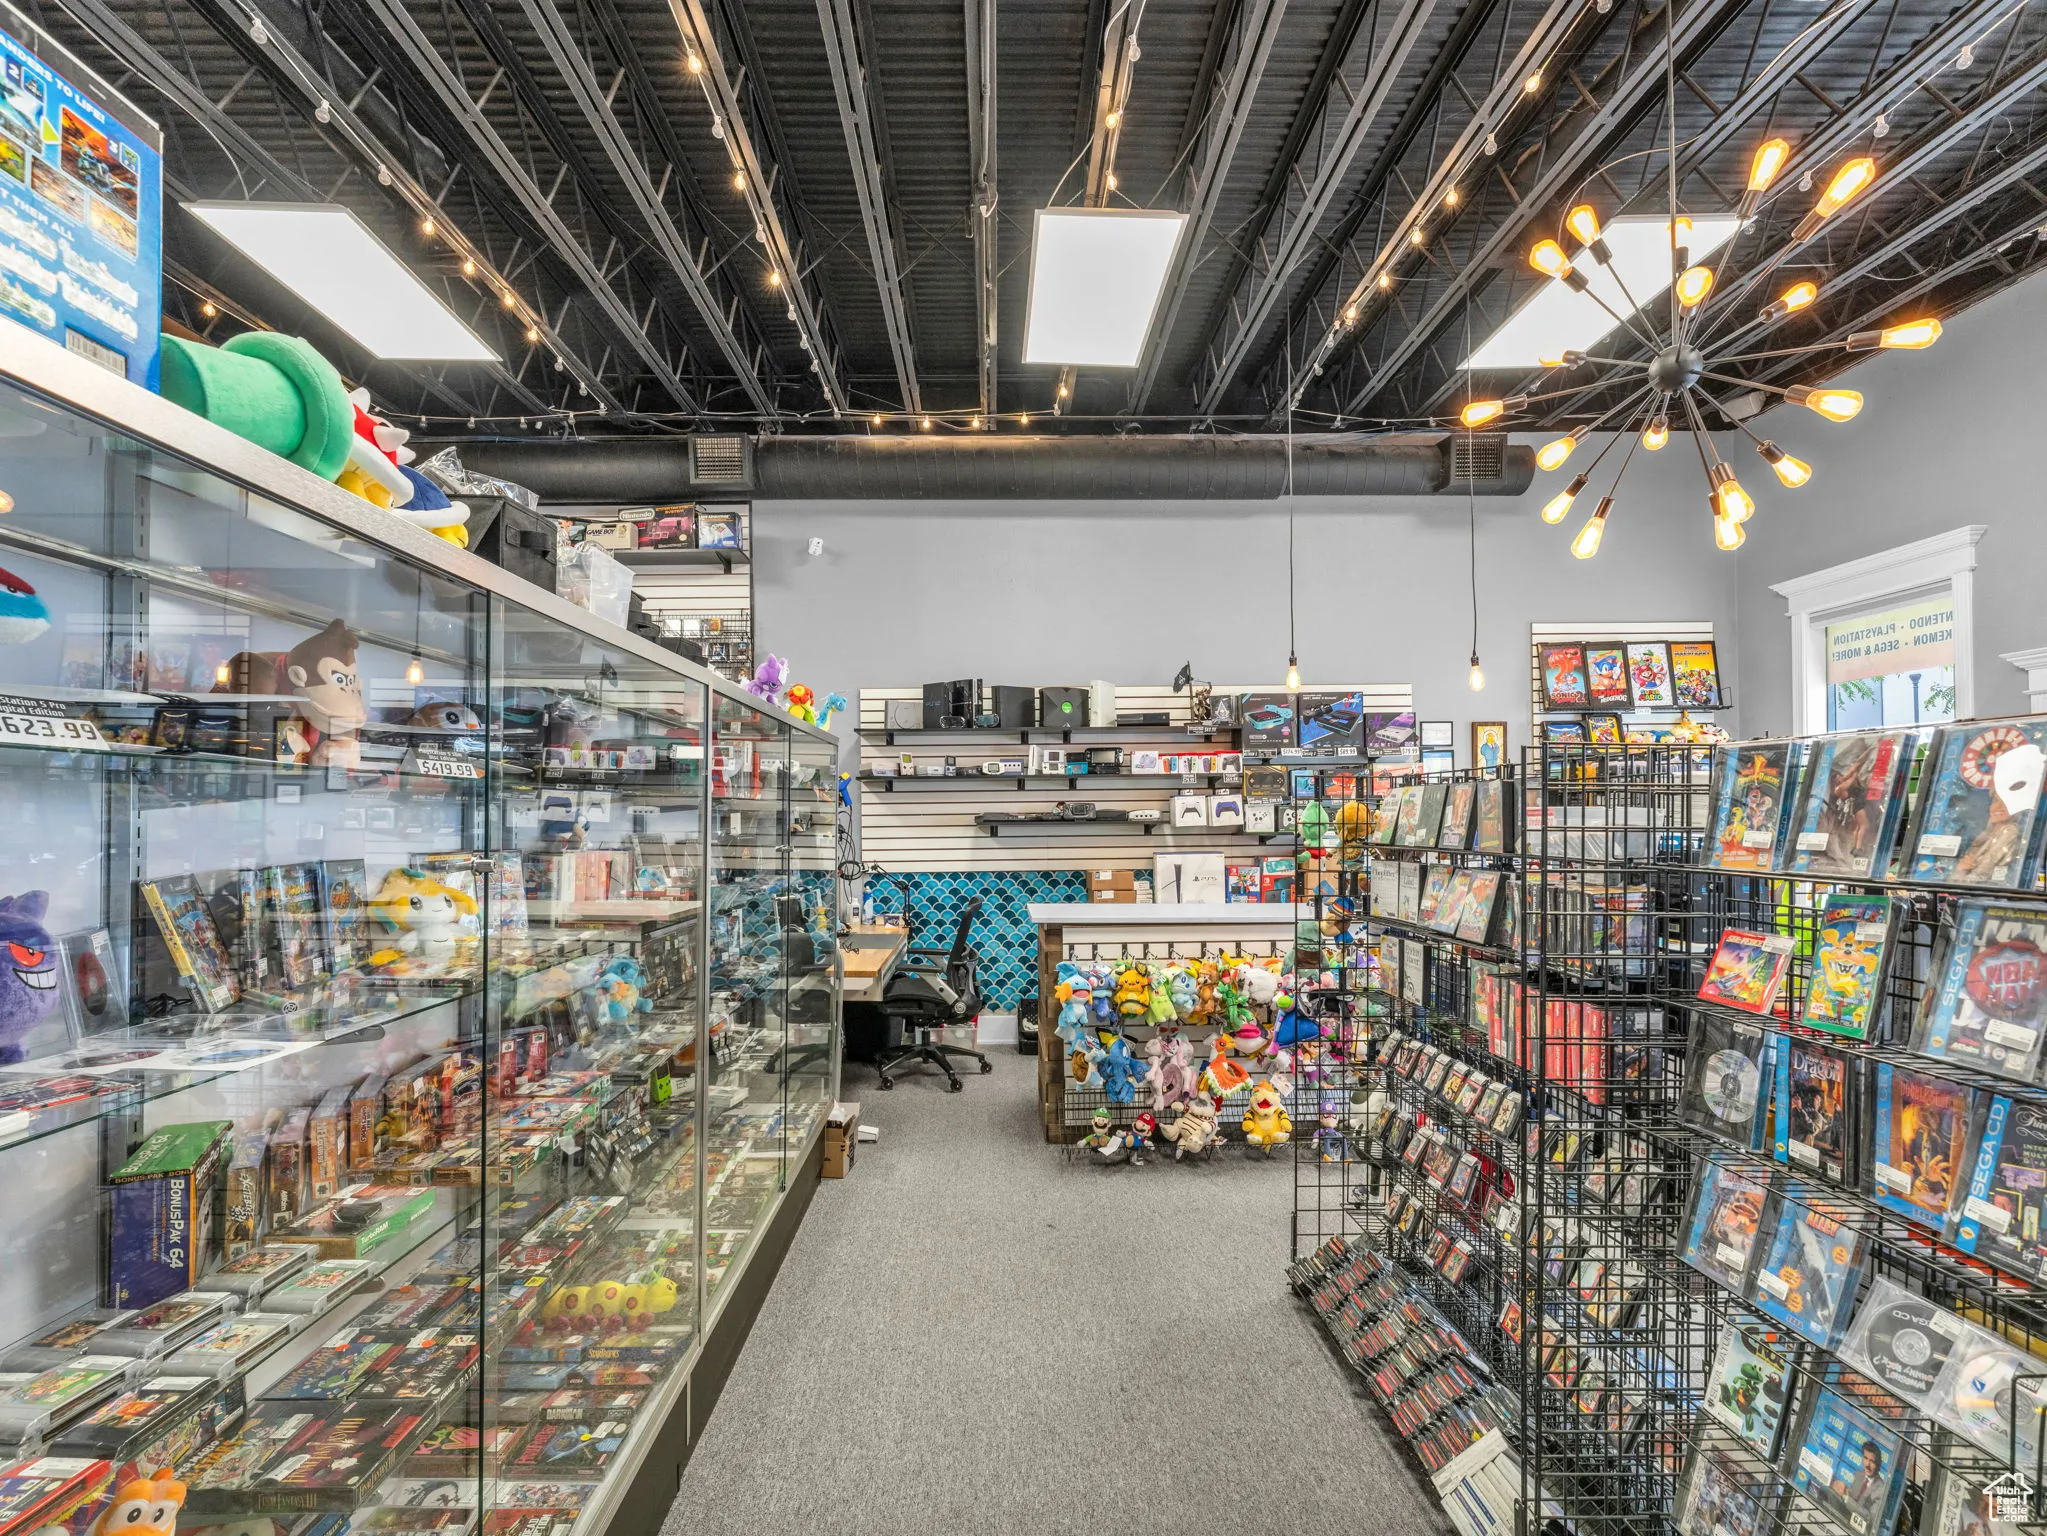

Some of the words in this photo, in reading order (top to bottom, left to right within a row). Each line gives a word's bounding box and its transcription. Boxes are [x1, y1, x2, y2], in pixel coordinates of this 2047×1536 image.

[8, 63, 20, 80] 2
[55, 79, 73, 98] TO
[51, 219, 75, 242] ALL
[622, 511, 652, 520] Nintendo
[1551, 692, 1575, 700] SONIC
[1575, 692, 1586, 703] 2
[1592, 689, 1623, 697] SONIC
[29, 708, 65, 717] Edition
[48, 702, 66, 710] Pro
[0, 716, 97, 740] 623.99
[422, 760, 472, 777] $419.99
[1929, 780, 1950, 831] SEGA
[1825, 907, 1864, 922] WONDER
[1864, 909, 1884, 923] DOG
[1942, 955, 1968, 1006] SEGA
[1958, 918, 1976, 950] CD
[1811, 1003, 1824, 1012] JVC
[1793, 1050, 1841, 1083] Dragon
[1971, 1141, 1998, 1198] SEGA
[1987, 1103, 2006, 1136] CD
[114, 1174, 147, 1184] BONUS
[147, 1172, 165, 1180] PAK
[240, 1171, 255, 1217] EXCITEBIKE
[361, 1221, 389, 1245] TurboRAM
[1806, 1211, 1841, 1238] ALLEY
[169, 1248, 184, 1269] 64
[1891, 1309, 1912, 1321] CD
[459, 1352, 491, 1388] BATMN
[1710, 1368, 1724, 1402] SEGA
[1721, 1325, 1734, 1367] SATURN
[546, 1408, 583, 1420] DARKMAN
[1828, 1414, 1844, 1431] $100
[335, 1417, 368, 1433] III
[1971, 1410, 2009, 1438] SEGA
[195, 1440, 220, 1462] MARIO
[1821, 1432, 1838, 1450] $200
[1847, 1449, 1862, 1467] $200
[307, 1493, 318, 1507] III
[1852, 1515, 1865, 1529] GA
